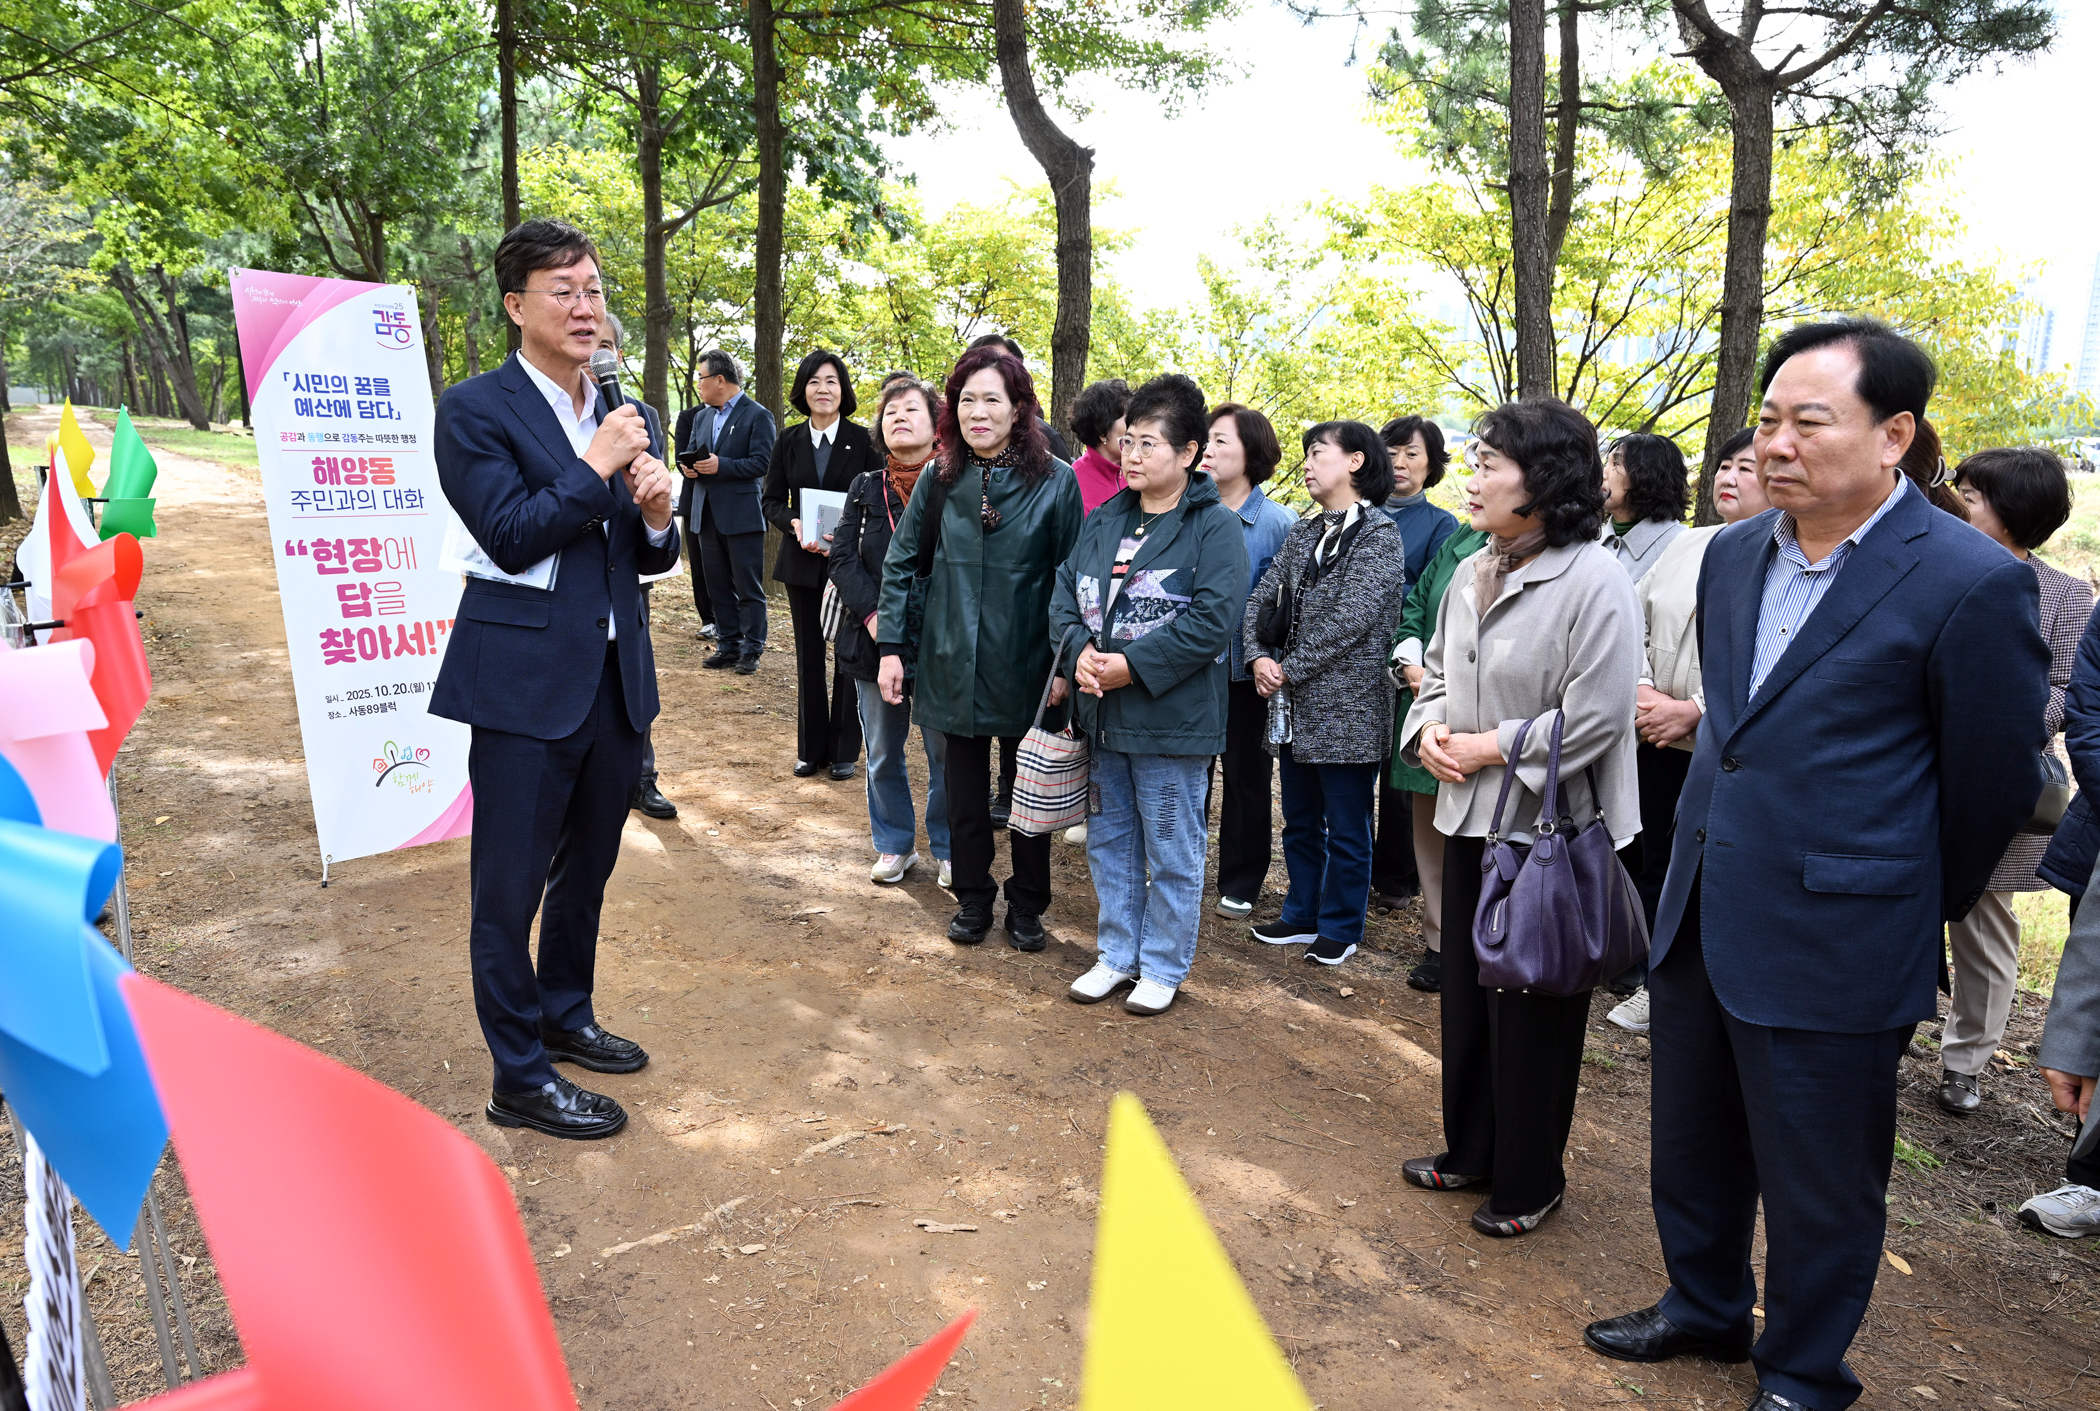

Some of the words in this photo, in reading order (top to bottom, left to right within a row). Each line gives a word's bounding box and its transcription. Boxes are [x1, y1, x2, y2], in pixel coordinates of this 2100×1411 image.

[283, 372, 349, 395] 「시민의
[354, 376, 392, 396] 꿈을
[294, 397, 352, 419] 예산에
[356, 400, 402, 421] 담다」
[280, 431, 306, 443] 공감과
[307, 432, 341, 443] 동행으로
[341, 433, 374, 444] 감동주는
[375, 433, 399, 444] 따뜻한
[400, 433, 417, 444] 행정
[311, 456, 396, 486] 해양동
[290, 489, 377, 512] 주민과의
[383, 488, 425, 510] 대화
[336, 581, 407, 619] 답을
[346, 688, 374, 701] 2025.
[349, 701, 397, 717] 사동89블럭
[392, 771, 420, 787] 함께
